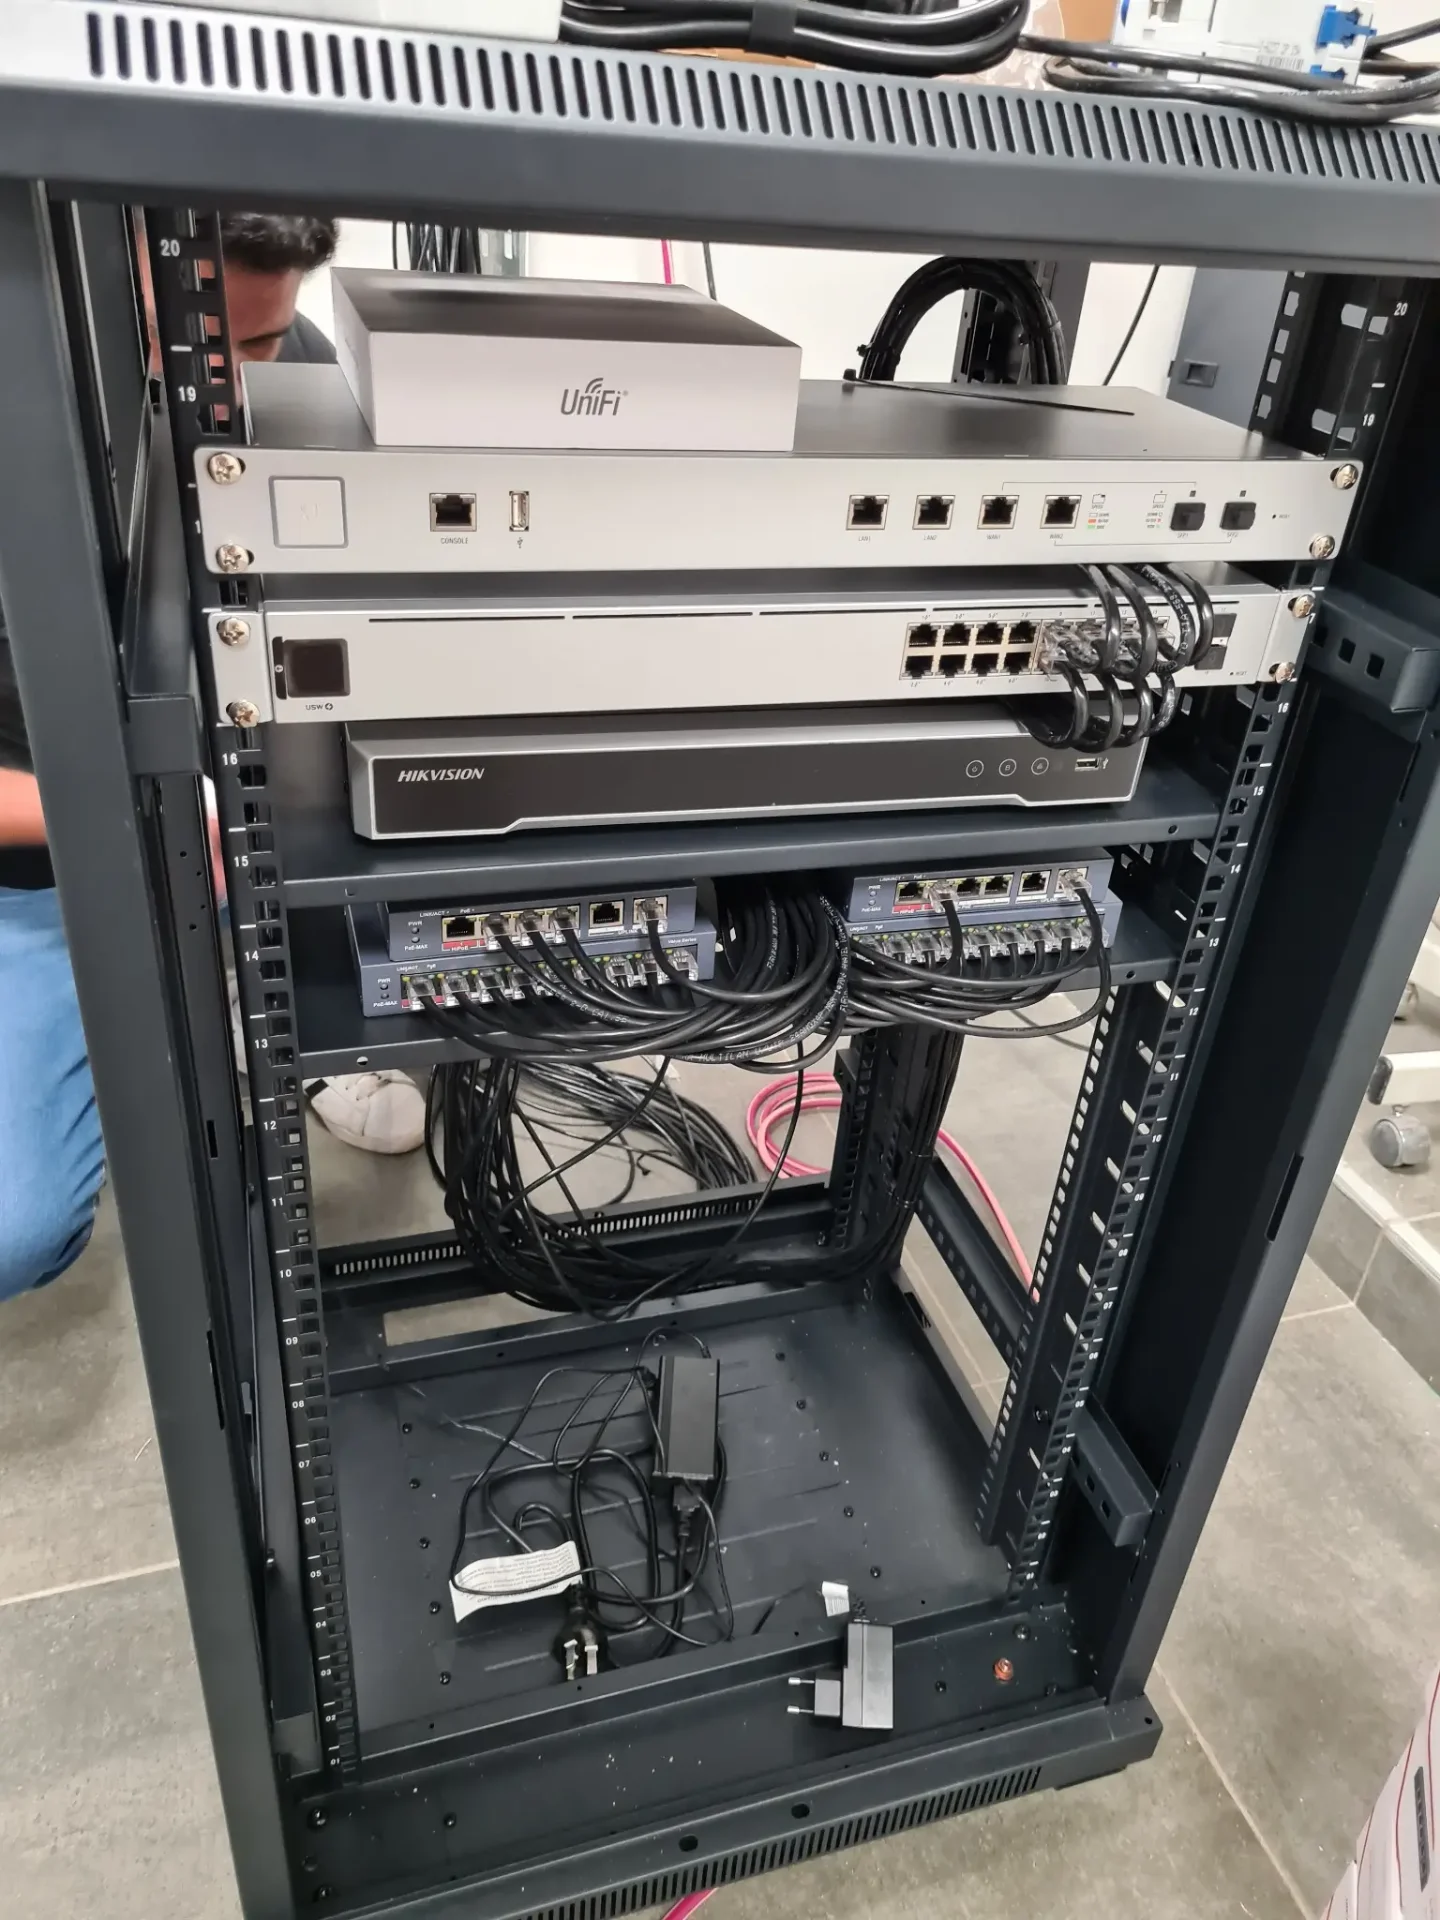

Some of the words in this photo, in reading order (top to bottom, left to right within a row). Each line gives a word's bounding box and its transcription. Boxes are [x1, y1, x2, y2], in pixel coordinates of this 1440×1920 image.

[160, 238, 180, 256] 20
[1394, 302, 1408, 316] 20
[178, 386, 196, 402] 19
[560, 379, 622, 416] UniFi
[1362, 413, 1376, 427] 19
[440, 537, 469, 545] CONSOLE
[1278, 702, 1290, 714] 16
[222, 752, 238, 766] 16
[397, 768, 485, 782] HIKVISION
[1253, 786, 1264, 796] 15
[234, 856, 249, 867] 15
[1230, 864, 1242, 874] 14
[1208, 938, 1220, 947] 13
[244, 950, 259, 962] 14
[1188, 1007, 1199, 1016] 12
[254, 1038, 268, 1049] 13
[1170, 1072, 1180, 1082] 11
[264, 1120, 277, 1131] 12
[1152, 1134, 1162, 1143] 10
[272, 1197, 284, 1208] 11
[279, 1268, 292, 1279] 10
[286, 1336, 298, 1346] 09
[292, 1400, 305, 1410] 08
[298, 1460, 310, 1470] 07
[304, 1516, 316, 1526] 06
[310, 1569, 322, 1579] 05
[316, 1620, 327, 1630] 04
[320, 1668, 332, 1677] 03
[325, 1714, 336, 1723] 02
[330, 1758, 341, 1766] 01
